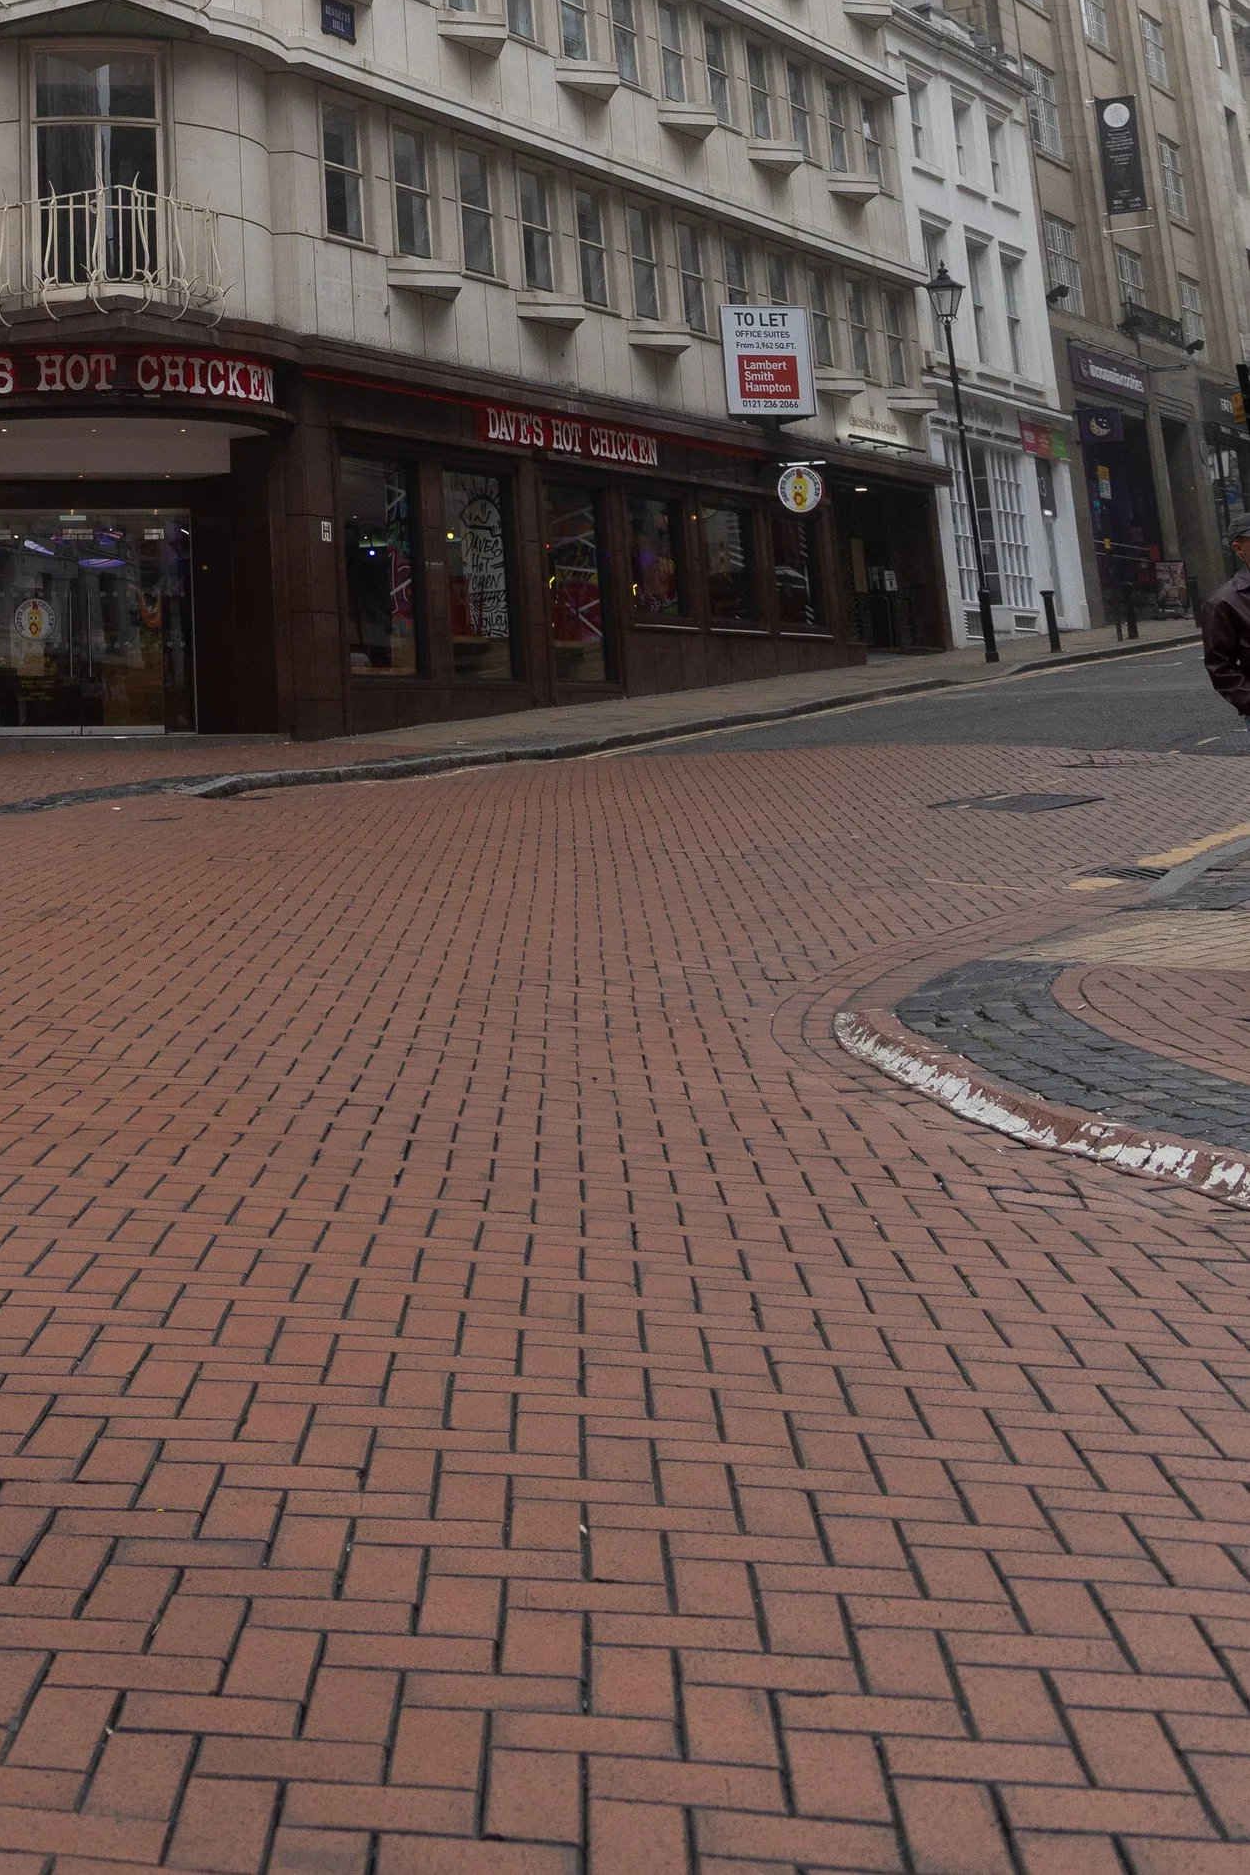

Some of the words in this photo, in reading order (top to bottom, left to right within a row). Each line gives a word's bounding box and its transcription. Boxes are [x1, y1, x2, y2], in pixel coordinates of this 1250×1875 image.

[332, 18, 346, 32] HILL
[734, 312, 755, 327] TO
[759, 312, 788, 327] LET
[735, 330, 762, 338] OFFICE
[763, 331, 791, 339] SUITES
[755, 342, 774, 350] 3,962
[743, 359, 787, 371] Lambert
[35, 353, 117, 393] HOT
[137, 354, 274, 405] CHICKEN
[744, 371, 775, 382] Smith
[745, 382, 792, 394] Hampton
[742, 399, 761, 408] 0121
[763, 400, 778, 408] 236
[780, 400, 799, 409] 2066
[487, 408, 545, 447] DAVE'S
[550, 419, 582, 454] HOT
[589, 427, 658, 466] CHICKEN
[784, 469, 796, 481] HOT
[802, 468, 821, 497] CHICKEN
